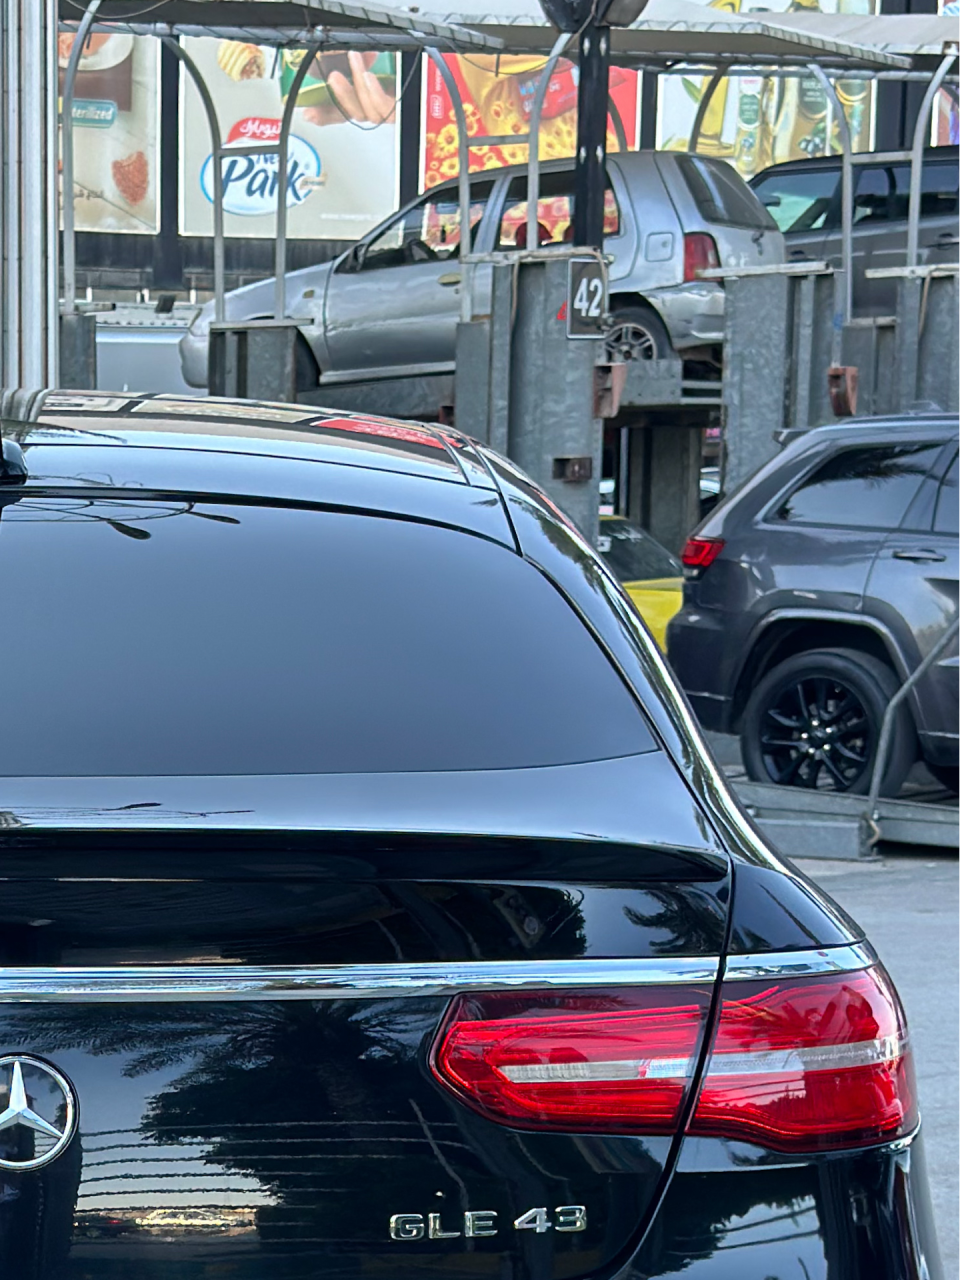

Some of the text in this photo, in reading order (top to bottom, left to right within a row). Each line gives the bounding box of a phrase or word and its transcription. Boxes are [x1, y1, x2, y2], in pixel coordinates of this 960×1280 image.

[221, 157, 306, 201] Park
[573, 277, 603, 317] 42
[390, 1205, 587, 1241] GLE 43
